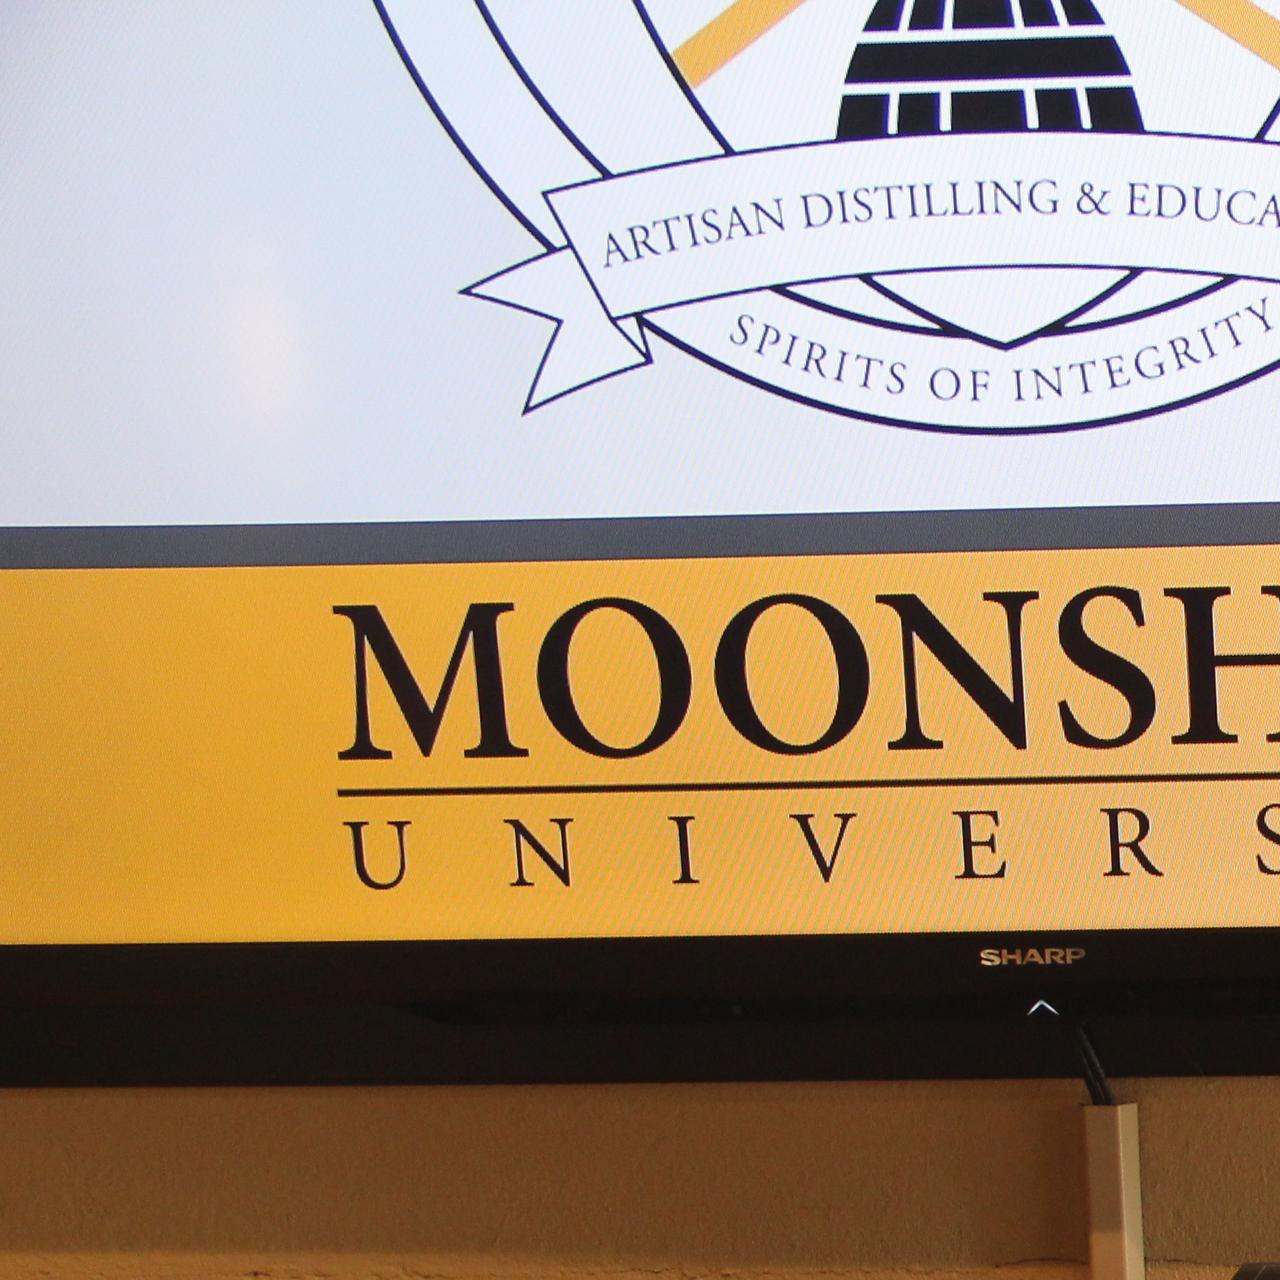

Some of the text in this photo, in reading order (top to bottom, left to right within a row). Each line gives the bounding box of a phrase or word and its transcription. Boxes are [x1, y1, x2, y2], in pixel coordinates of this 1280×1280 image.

[603, 198, 786, 268] ARTISAN
[801, 179, 1059, 229] DISTILLING
[1077, 182, 1112, 216] &
[729, 296, 1275, 402] SPIRITS OF INTEGRITY
[980, 948, 1087, 966] SHARP
